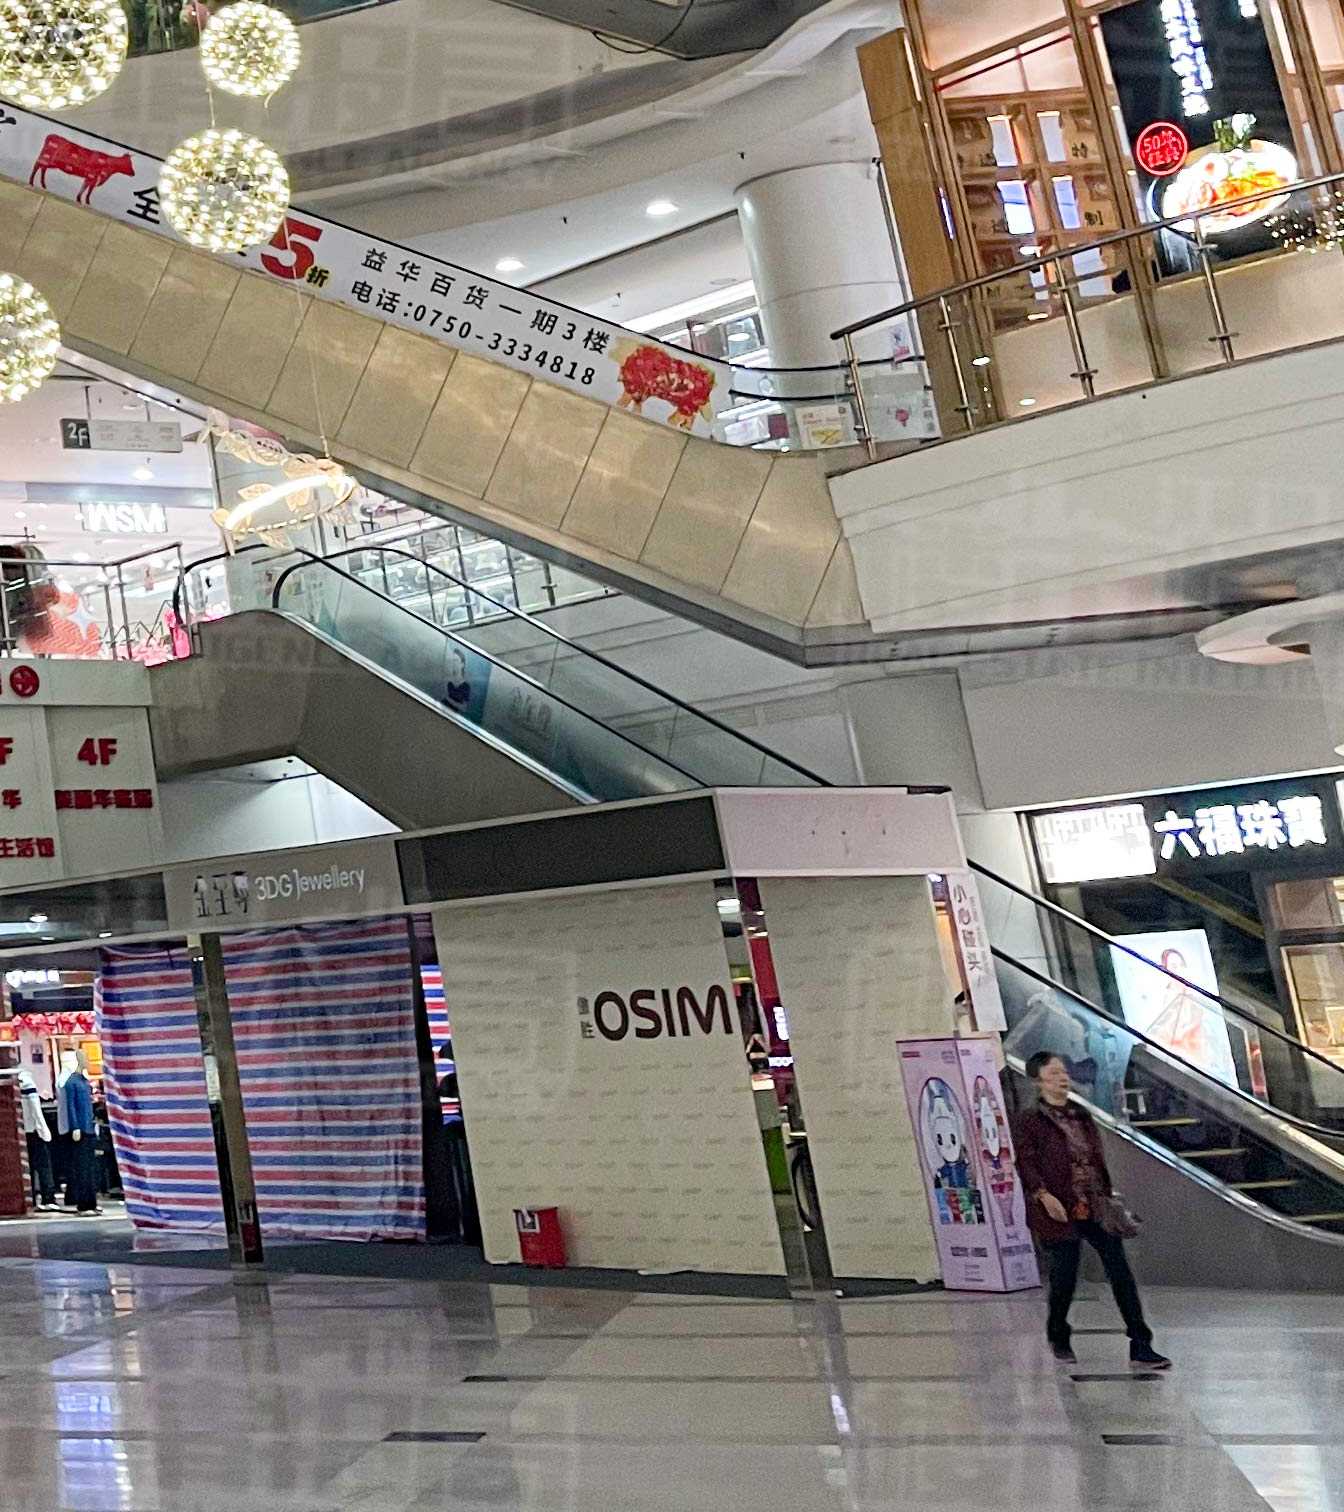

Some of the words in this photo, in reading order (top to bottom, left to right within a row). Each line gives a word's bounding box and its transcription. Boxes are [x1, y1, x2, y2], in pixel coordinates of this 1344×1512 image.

[360, 247, 611, 355] 益华百货一期3楼
[67, 421, 89, 447] 2F
[87, 502, 166, 534] WSM
[78, 738, 118, 767] 4F
[255, 874, 293, 901] 3DG
[294, 864, 365, 901] Jewellery
[594, 984, 734, 1042] OSIM
